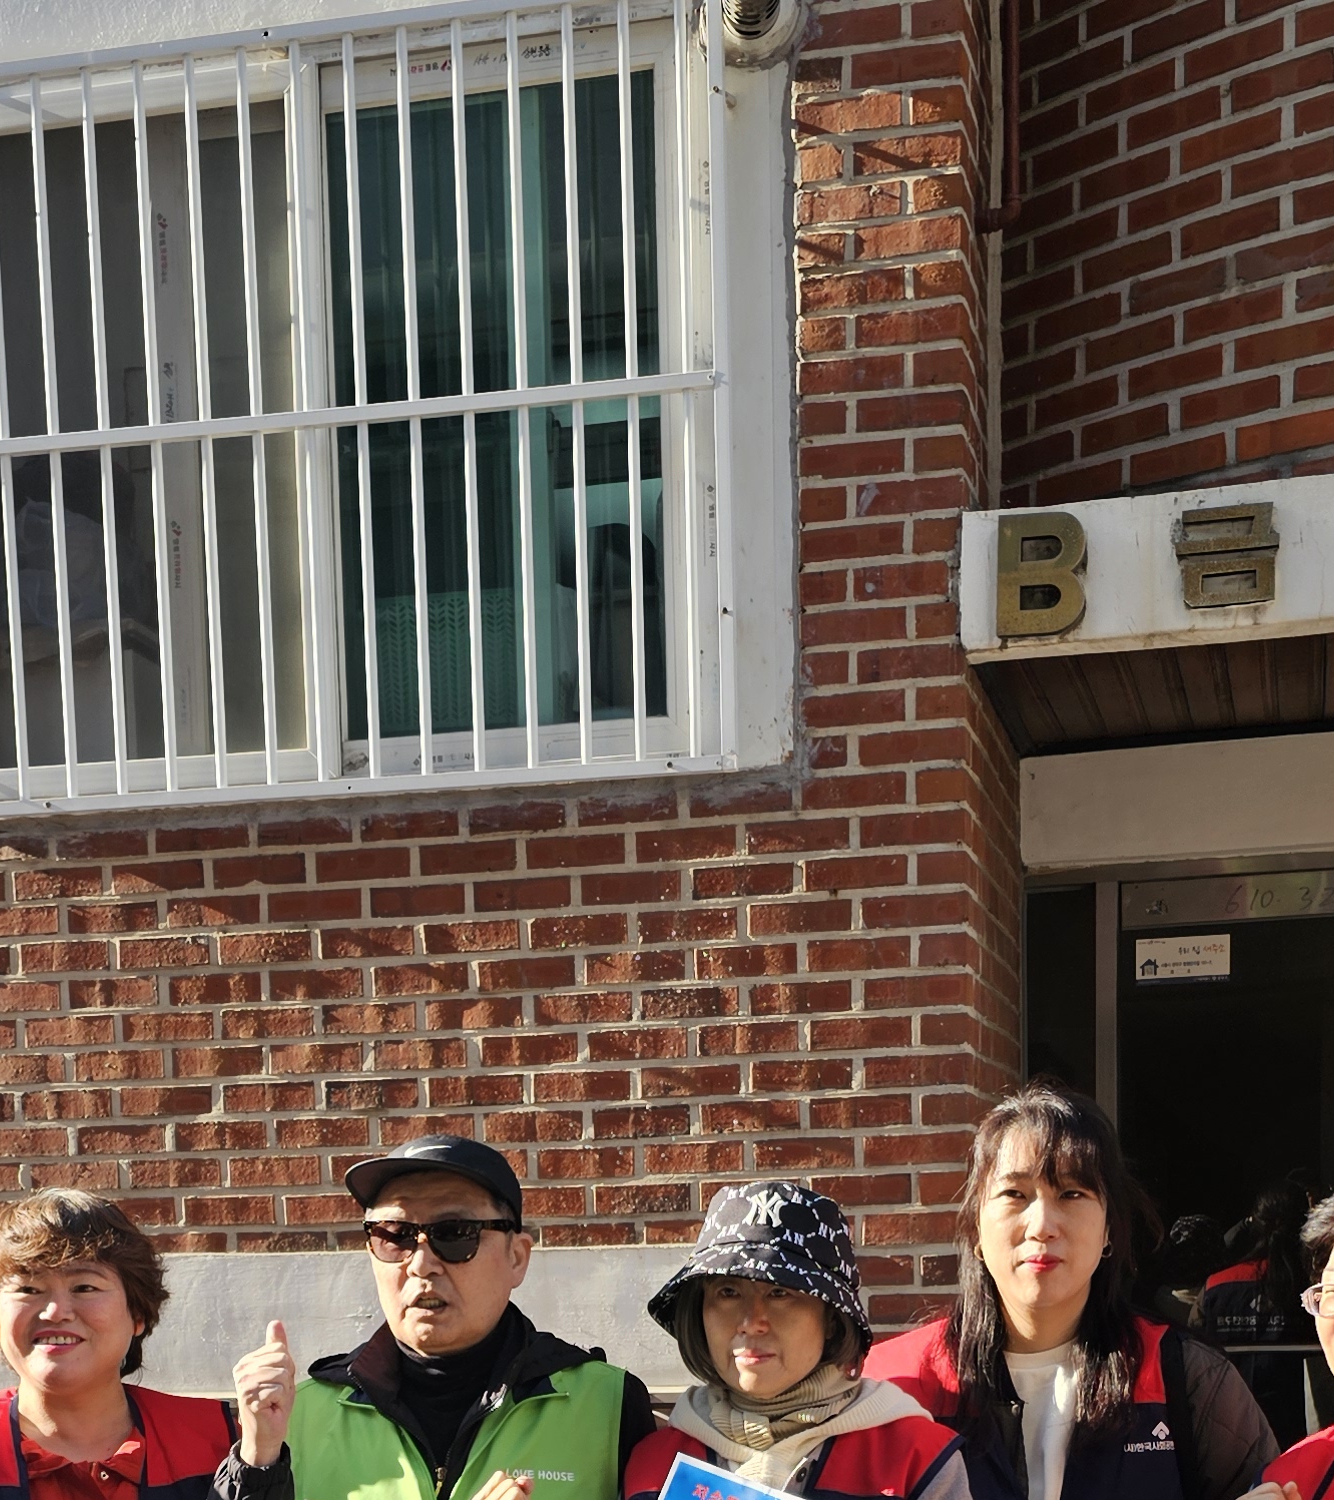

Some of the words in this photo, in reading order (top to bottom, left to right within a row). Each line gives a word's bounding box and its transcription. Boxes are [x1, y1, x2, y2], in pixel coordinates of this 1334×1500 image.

[996, 511, 1088, 638] B
[506, 1468, 534, 1480] LOVE
[538, 1470, 576, 1482] HOUSE
